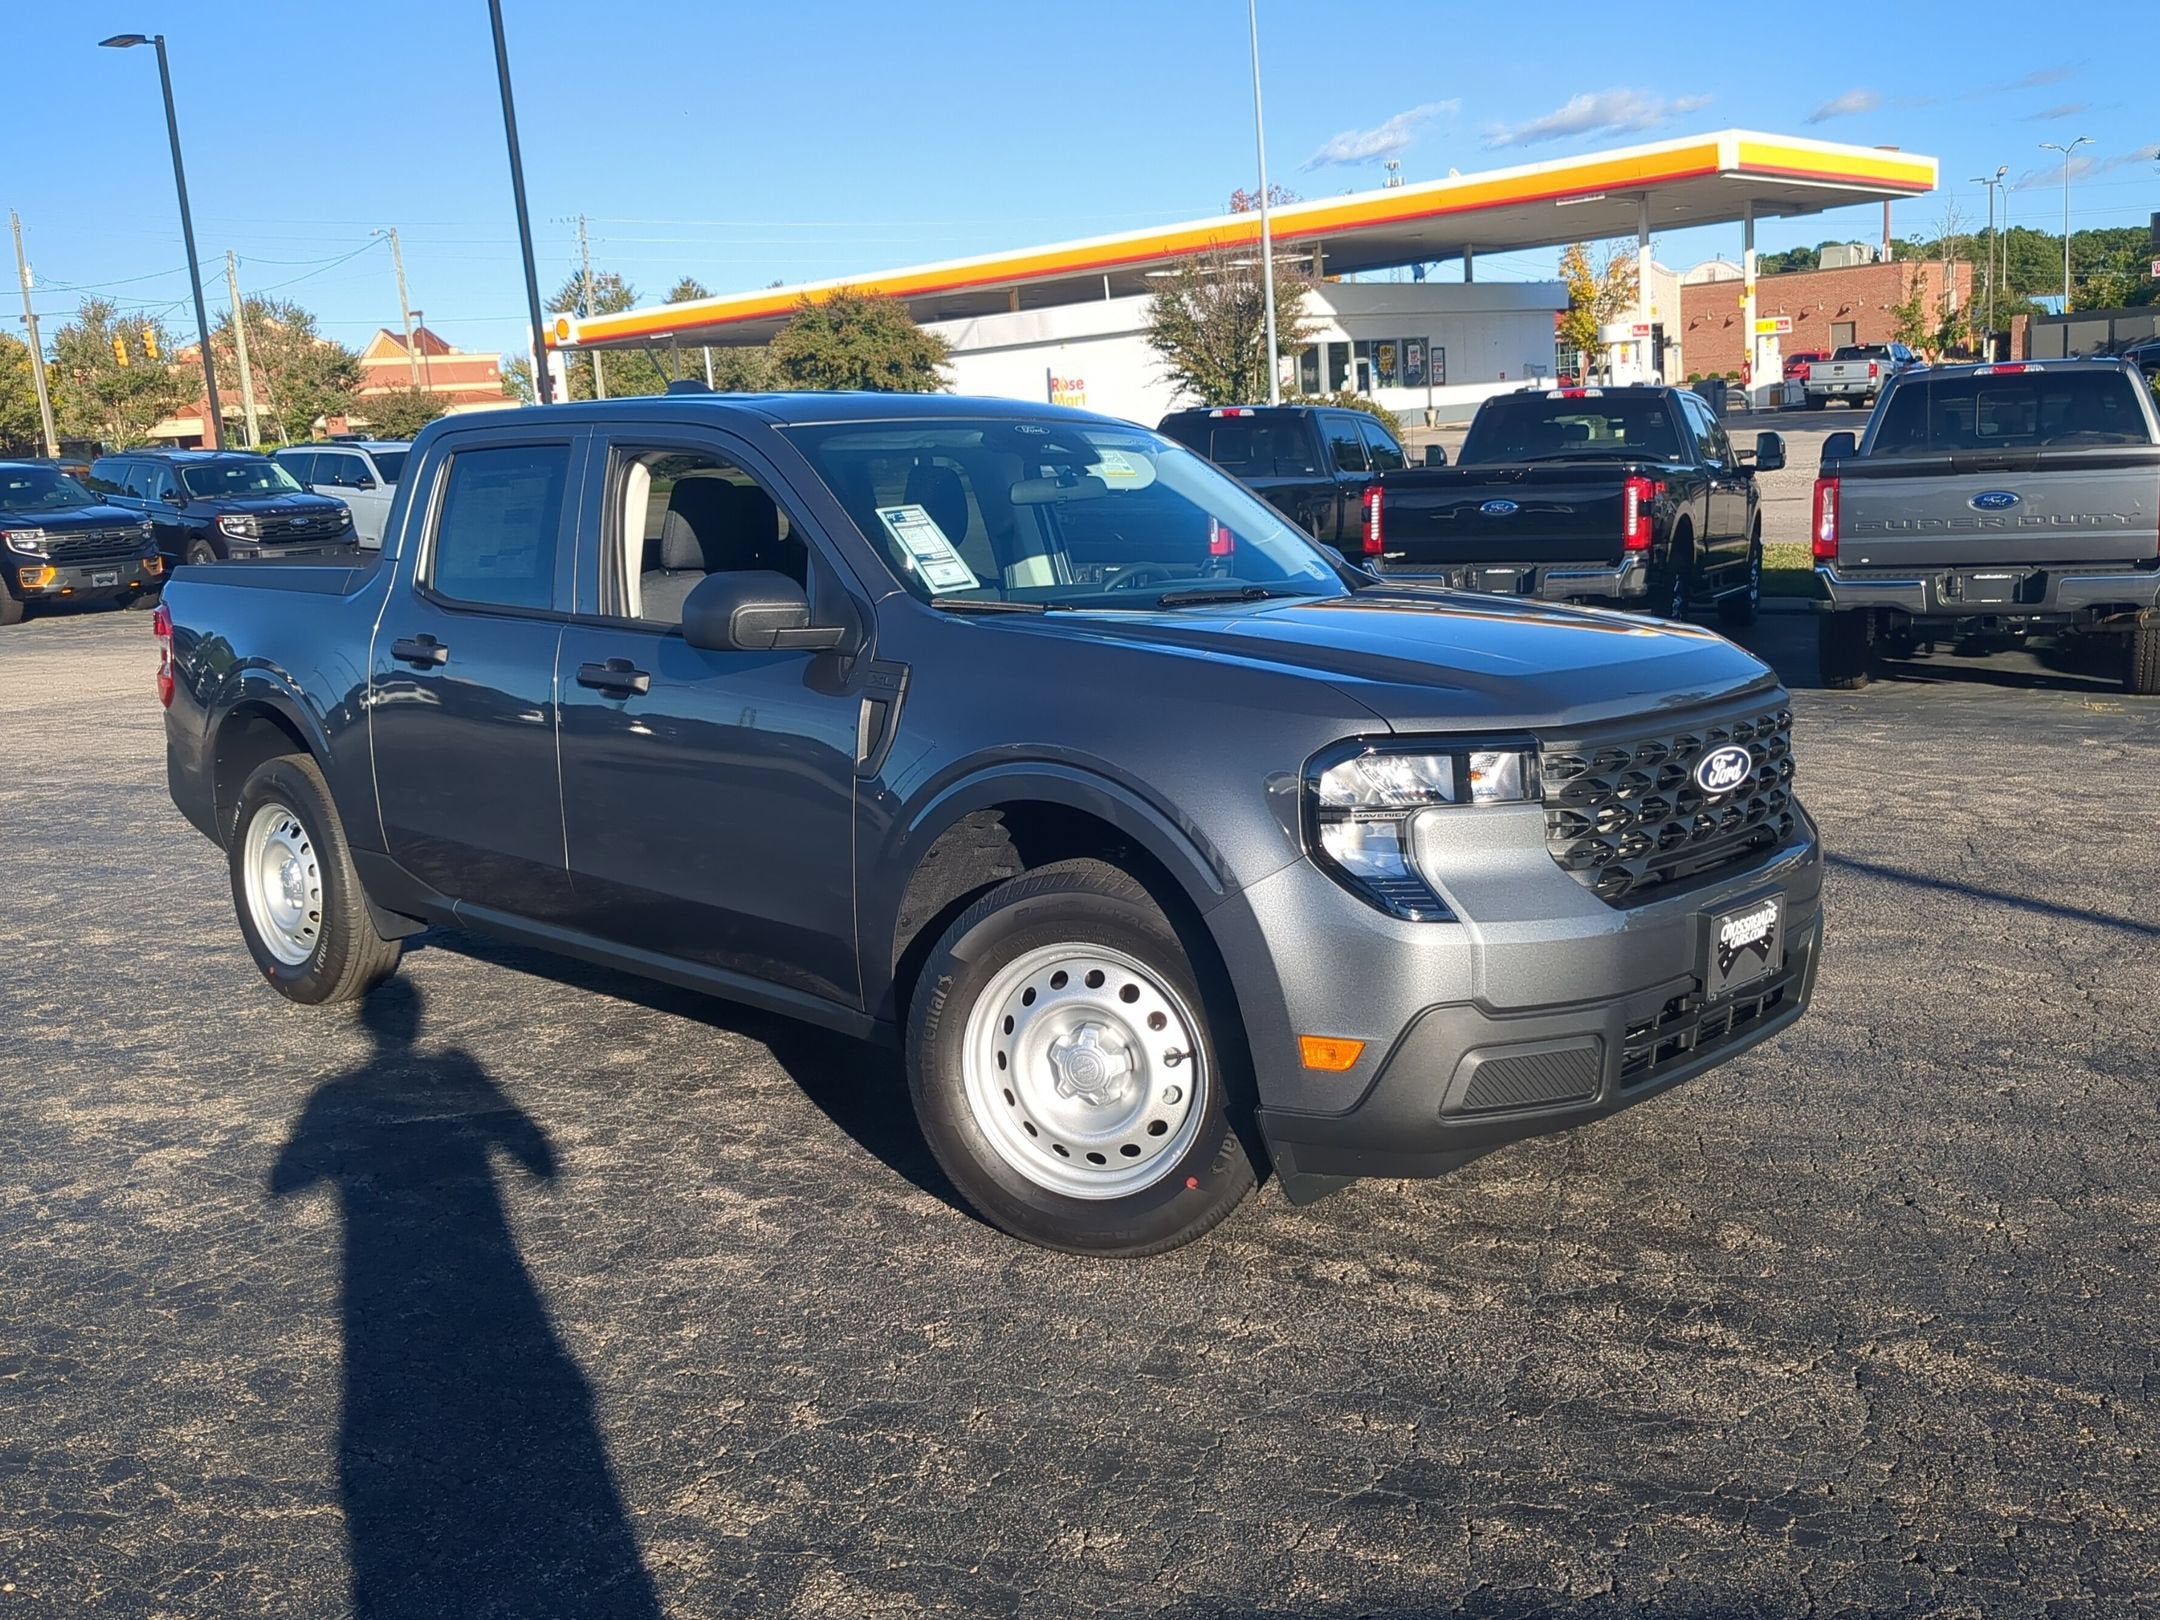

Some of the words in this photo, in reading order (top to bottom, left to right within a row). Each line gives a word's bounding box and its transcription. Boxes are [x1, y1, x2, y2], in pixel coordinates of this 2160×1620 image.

[1051, 377, 1084, 392] Rose
[1053, 392, 1086, 407] Mart
[1855, 516, 2005, 532] SUPER
[2018, 511, 2141, 528] DUTY
[1708, 753, 1743, 787] Ford
[1721, 908, 1778, 942] CROSSROADS
